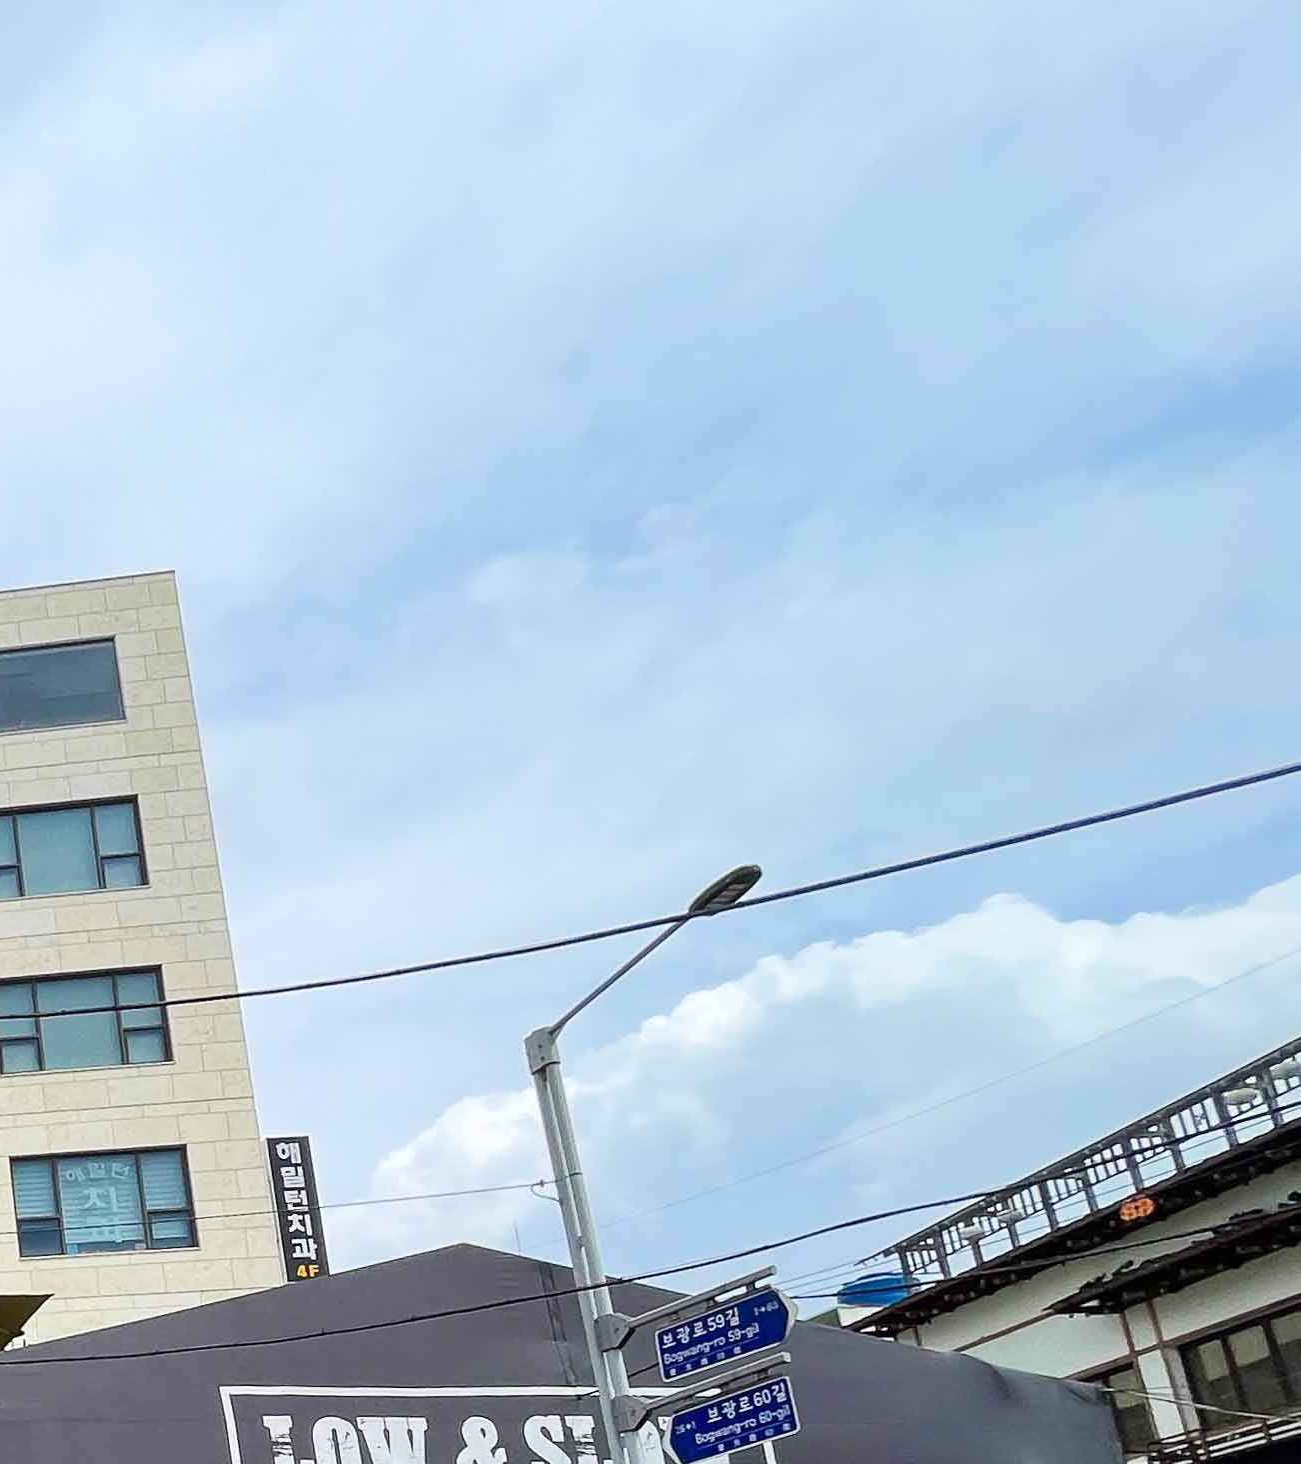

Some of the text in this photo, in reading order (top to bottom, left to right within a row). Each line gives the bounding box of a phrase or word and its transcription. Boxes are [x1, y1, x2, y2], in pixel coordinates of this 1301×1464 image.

[275, 1142, 318, 1261] 해밀턴치과
[296, 1264, 320, 1279] 4F
[662, 1307, 740, 1349] 보광로59길
[663, 1336, 726, 1365] Bogwang-ro
[727, 1322, 760, 1343] 59-gil
[707, 1382, 788, 1424] 보광로60길
[695, 1417, 758, 1445] Bogwang-ro
[758, 1404, 792, 1425] 60-gil
